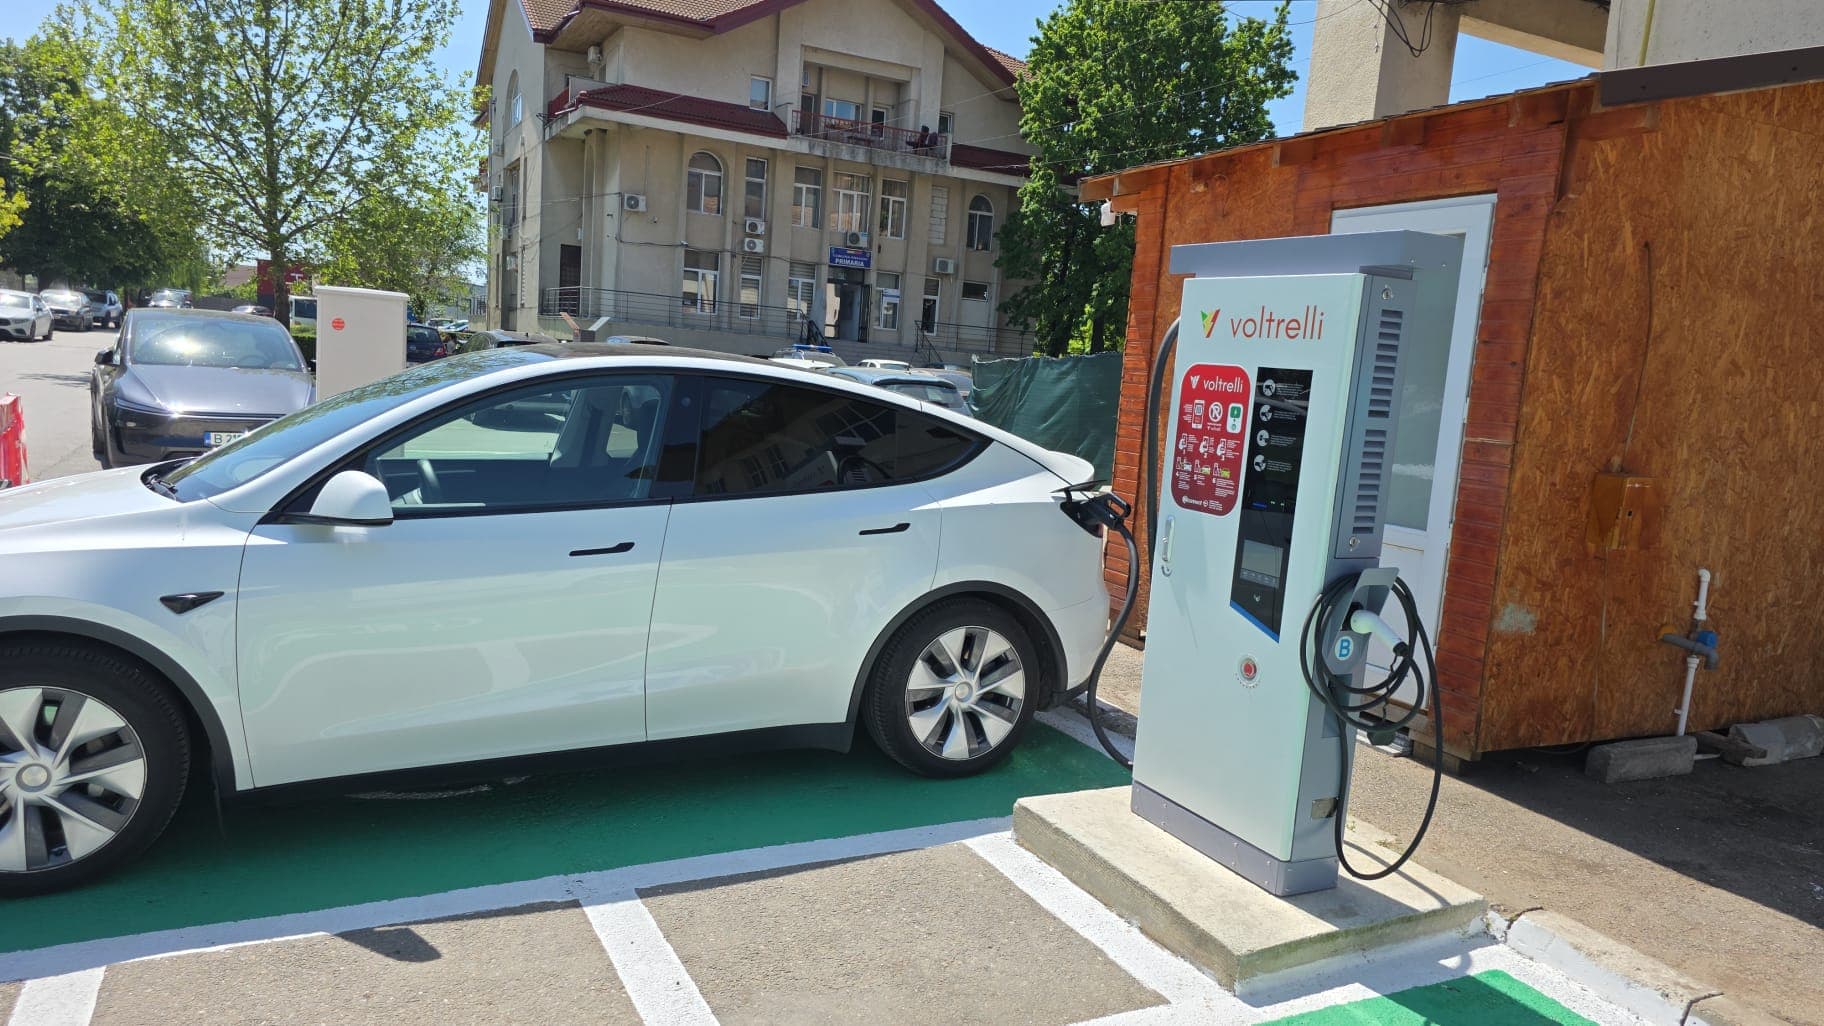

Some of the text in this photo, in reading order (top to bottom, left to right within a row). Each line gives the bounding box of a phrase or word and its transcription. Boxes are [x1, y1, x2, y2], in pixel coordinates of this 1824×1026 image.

[835, 258, 864, 266] PRIMARIA
[1230, 304, 1325, 340] voltrelli
[1203, 376, 1243, 393] voltrelli
[214, 434, 223, 444] B
[1339, 639, 1351, 657] B
